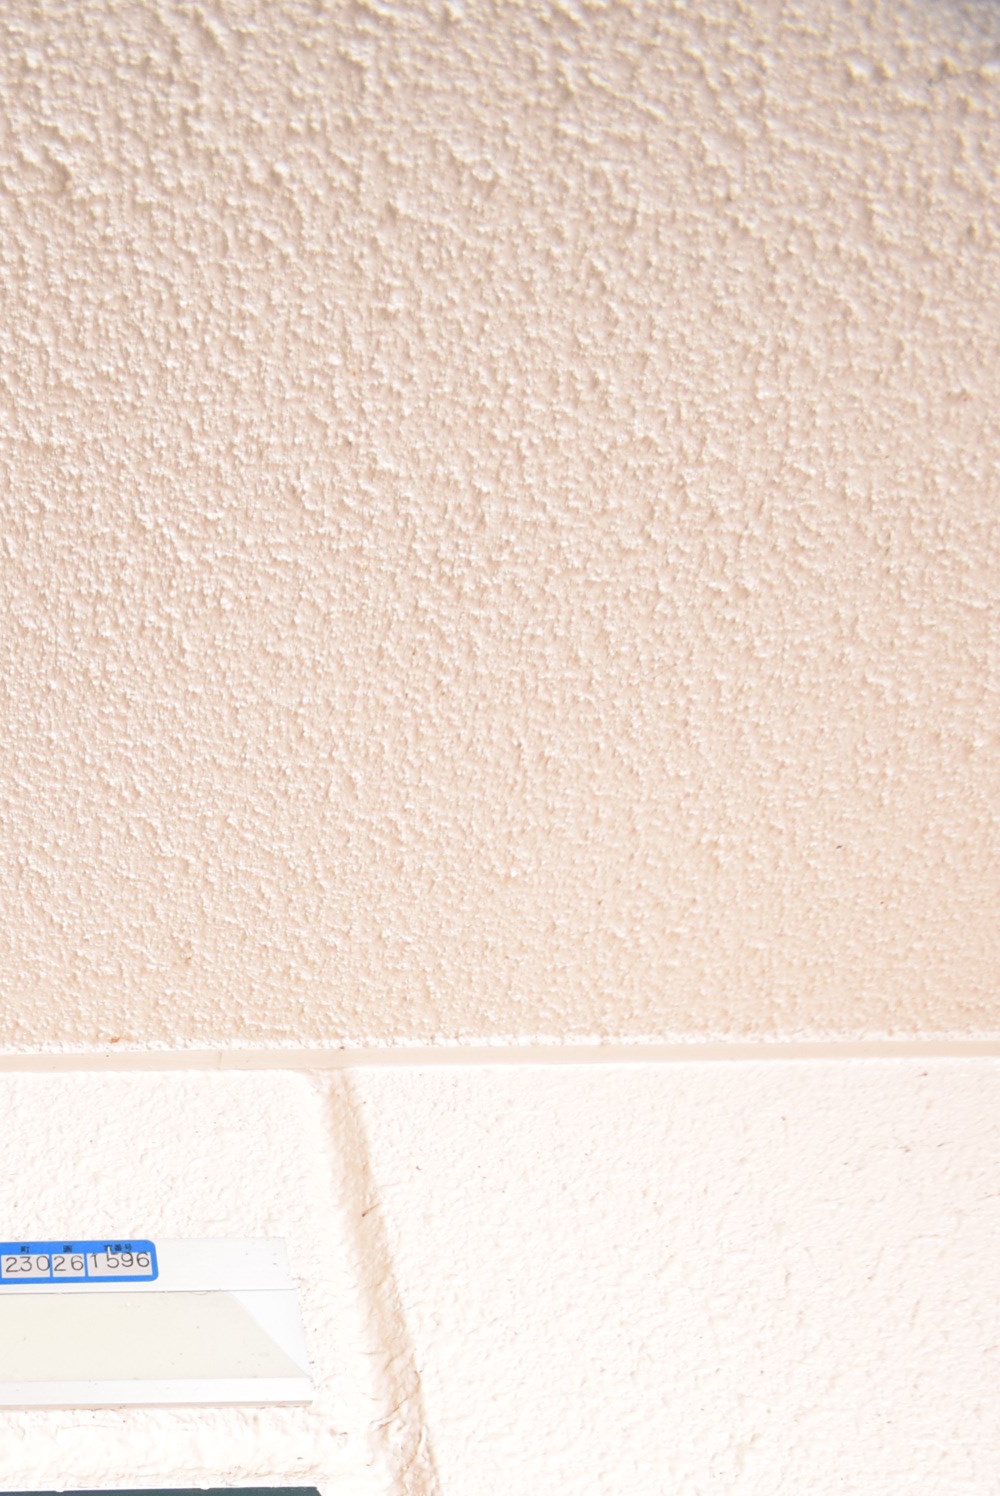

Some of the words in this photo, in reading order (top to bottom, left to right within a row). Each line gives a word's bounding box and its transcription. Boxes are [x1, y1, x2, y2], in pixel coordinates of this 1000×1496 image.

[5, 1255, 51, 1273] 230
[53, 1254, 84, 1272] 26
[90, 1252, 150, 1269] 1596
